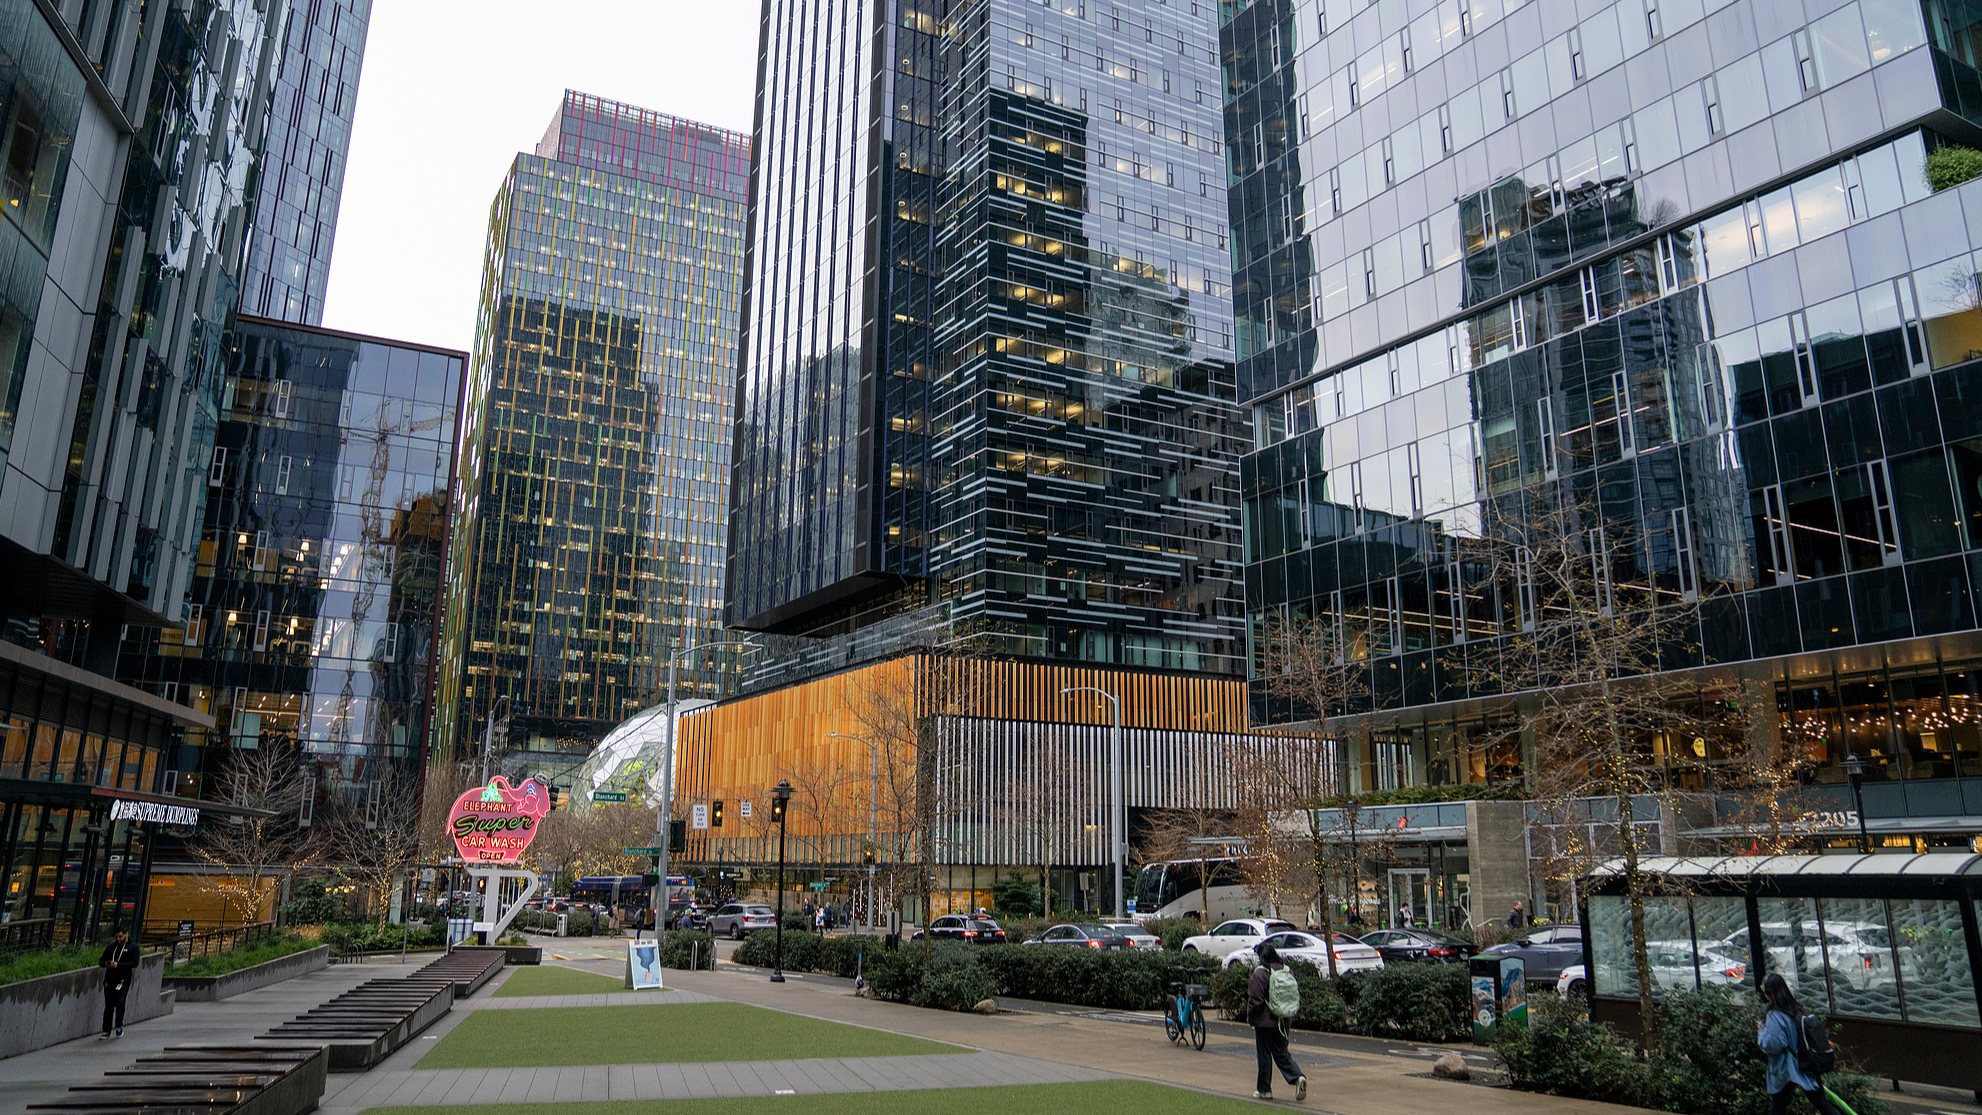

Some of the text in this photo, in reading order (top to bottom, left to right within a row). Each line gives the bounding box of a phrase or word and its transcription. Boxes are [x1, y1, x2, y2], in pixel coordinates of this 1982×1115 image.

[595, 793, 618, 801] Blanchard
[463, 801, 513, 813] ELEPHANT
[136, 801, 167, 823] SUPREME
[165, 805, 200, 826] DUMPLINGS
[454, 814, 535, 838] Super
[461, 836, 524, 849] CAR WASH
[481, 852, 501, 860] OPEN
